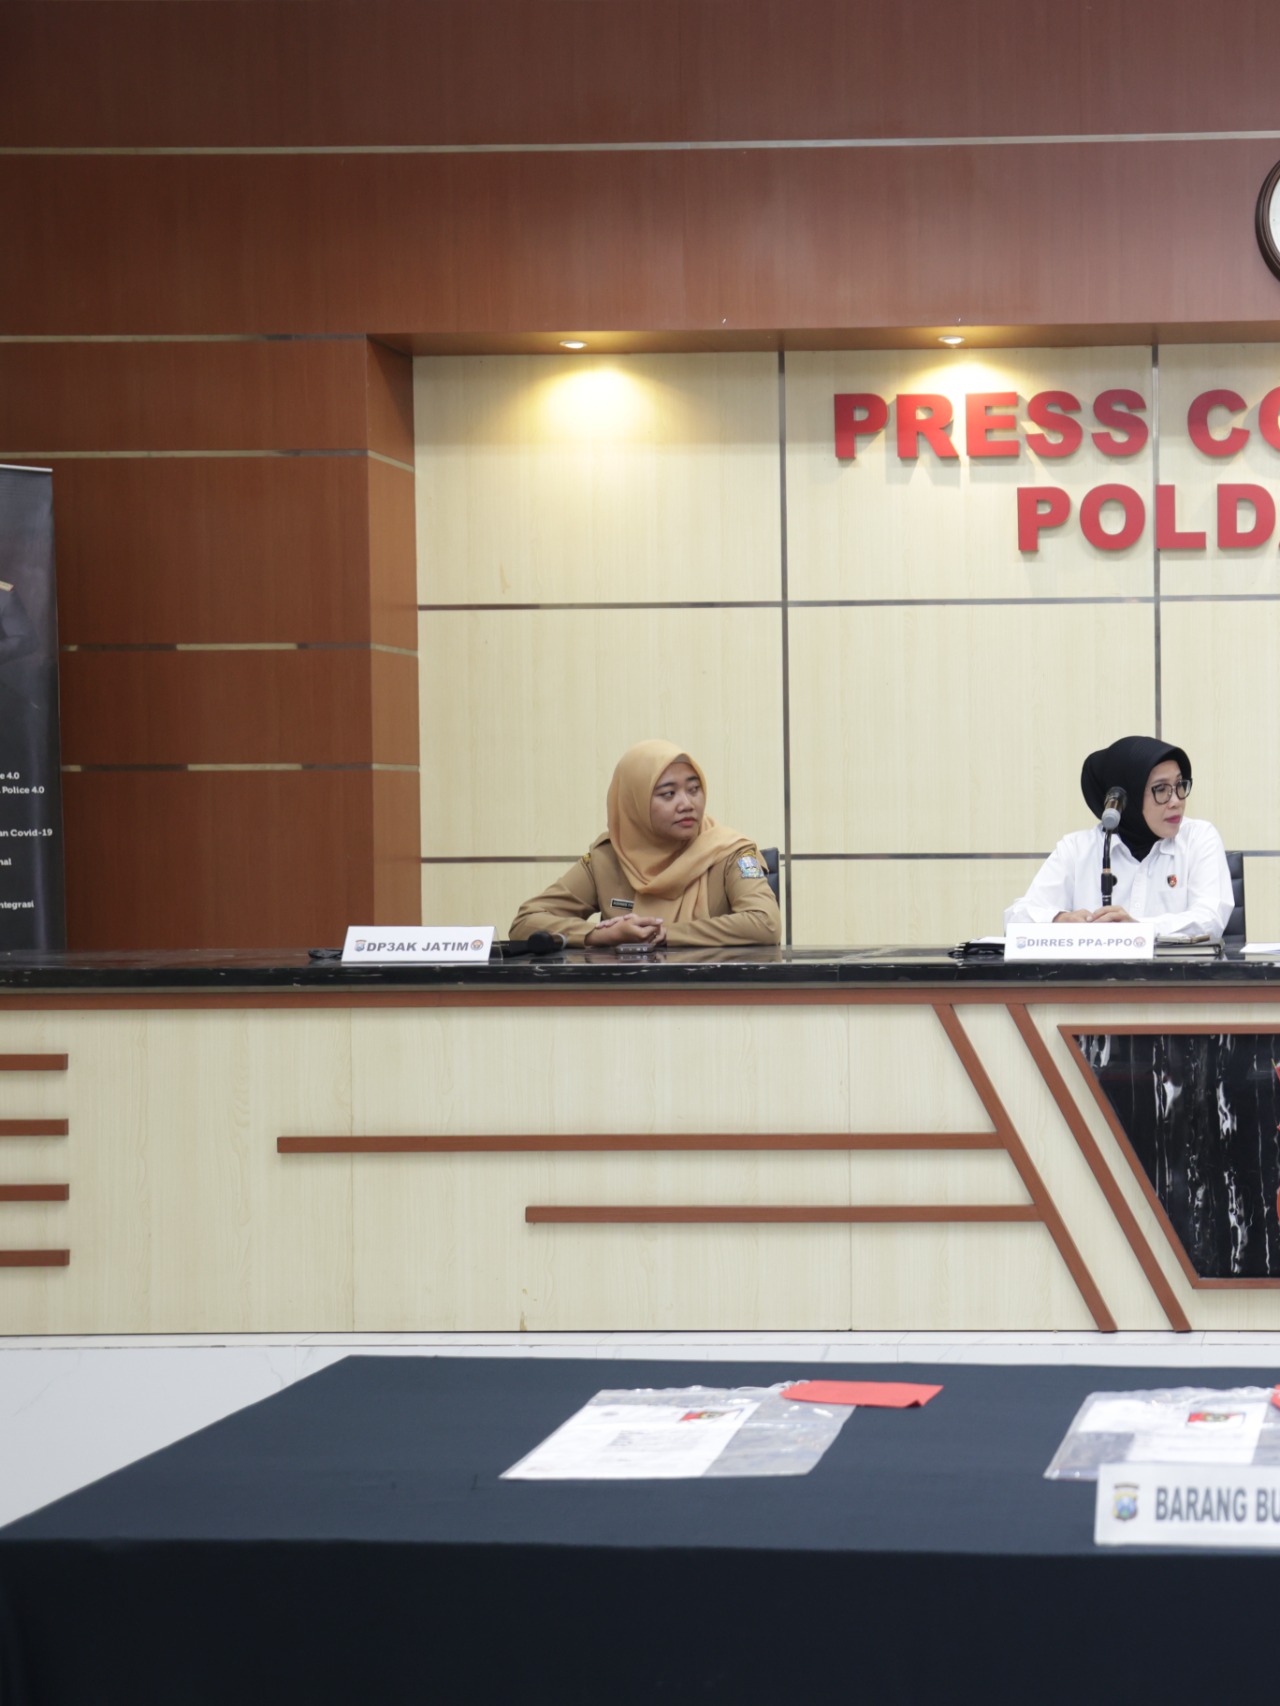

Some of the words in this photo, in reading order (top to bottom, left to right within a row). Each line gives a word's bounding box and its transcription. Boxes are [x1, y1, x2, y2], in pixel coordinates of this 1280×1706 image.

[832, 387, 1149, 460] PRESS
[2, 785, 30, 794] Police
[10, 828, 53, 837] Covid-19
[366, 941, 417, 952] DP3AK
[421, 941, 469, 952] JATIM
[1027, 938, 1074, 947] DIRRES
[1078, 938, 1133, 947] PPA-PPO
[1155, 1486, 1248, 1523] BARANG
